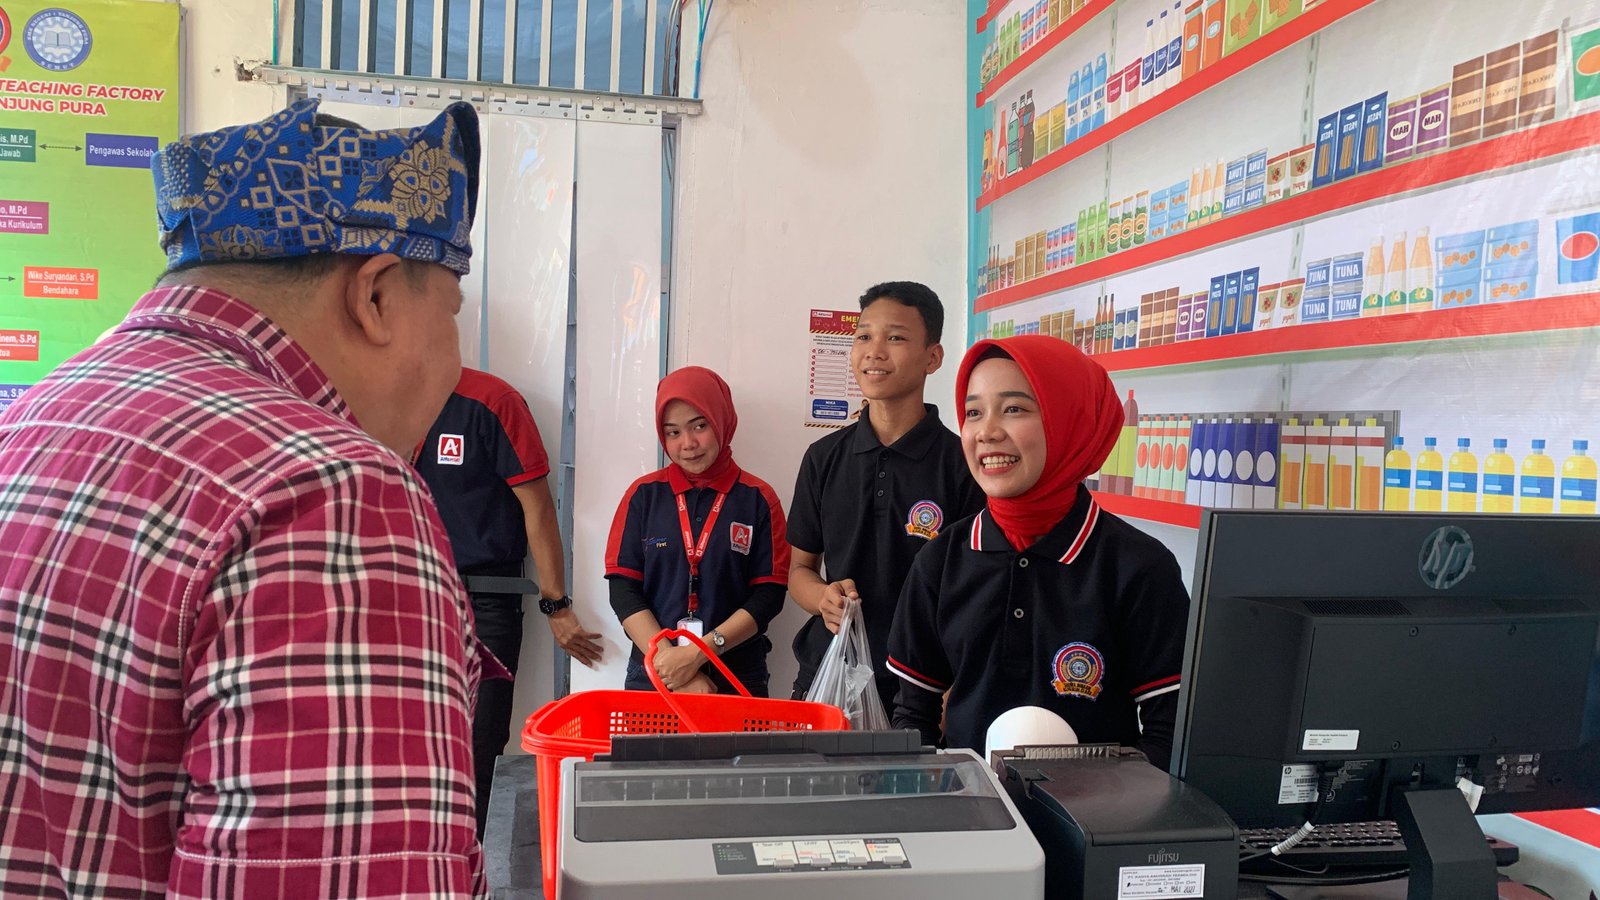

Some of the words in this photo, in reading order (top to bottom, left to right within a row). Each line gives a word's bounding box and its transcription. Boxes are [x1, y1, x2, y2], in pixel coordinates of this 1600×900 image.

[0, 79, 83, 96] TEACHING
[87, 85, 165, 101] FACTORY
[0, 97, 54, 112] NJUNG
[60, 101, 106, 115] PURA
[0, 134, 9, 143] is,
[11, 134, 29, 144] M.Pd
[89, 145, 125, 157] Pengawas
[0, 206, 8, 215] o,
[9, 205, 28, 215] M.Pd
[8, 220, 43, 230] Kurikulum
[1309, 269, 1327, 284] TUNA
[1336, 264, 1359, 279] TUNA
[43, 285, 79, 295] Bendahara
[1304, 302, 1325, 316] TUNA
[1335, 298, 1357, 312] TUNA
[0, 333, 19, 343] inem,
[20, 334, 37, 344] S.Pd
[1148, 848, 1179, 864] FUJITSU
